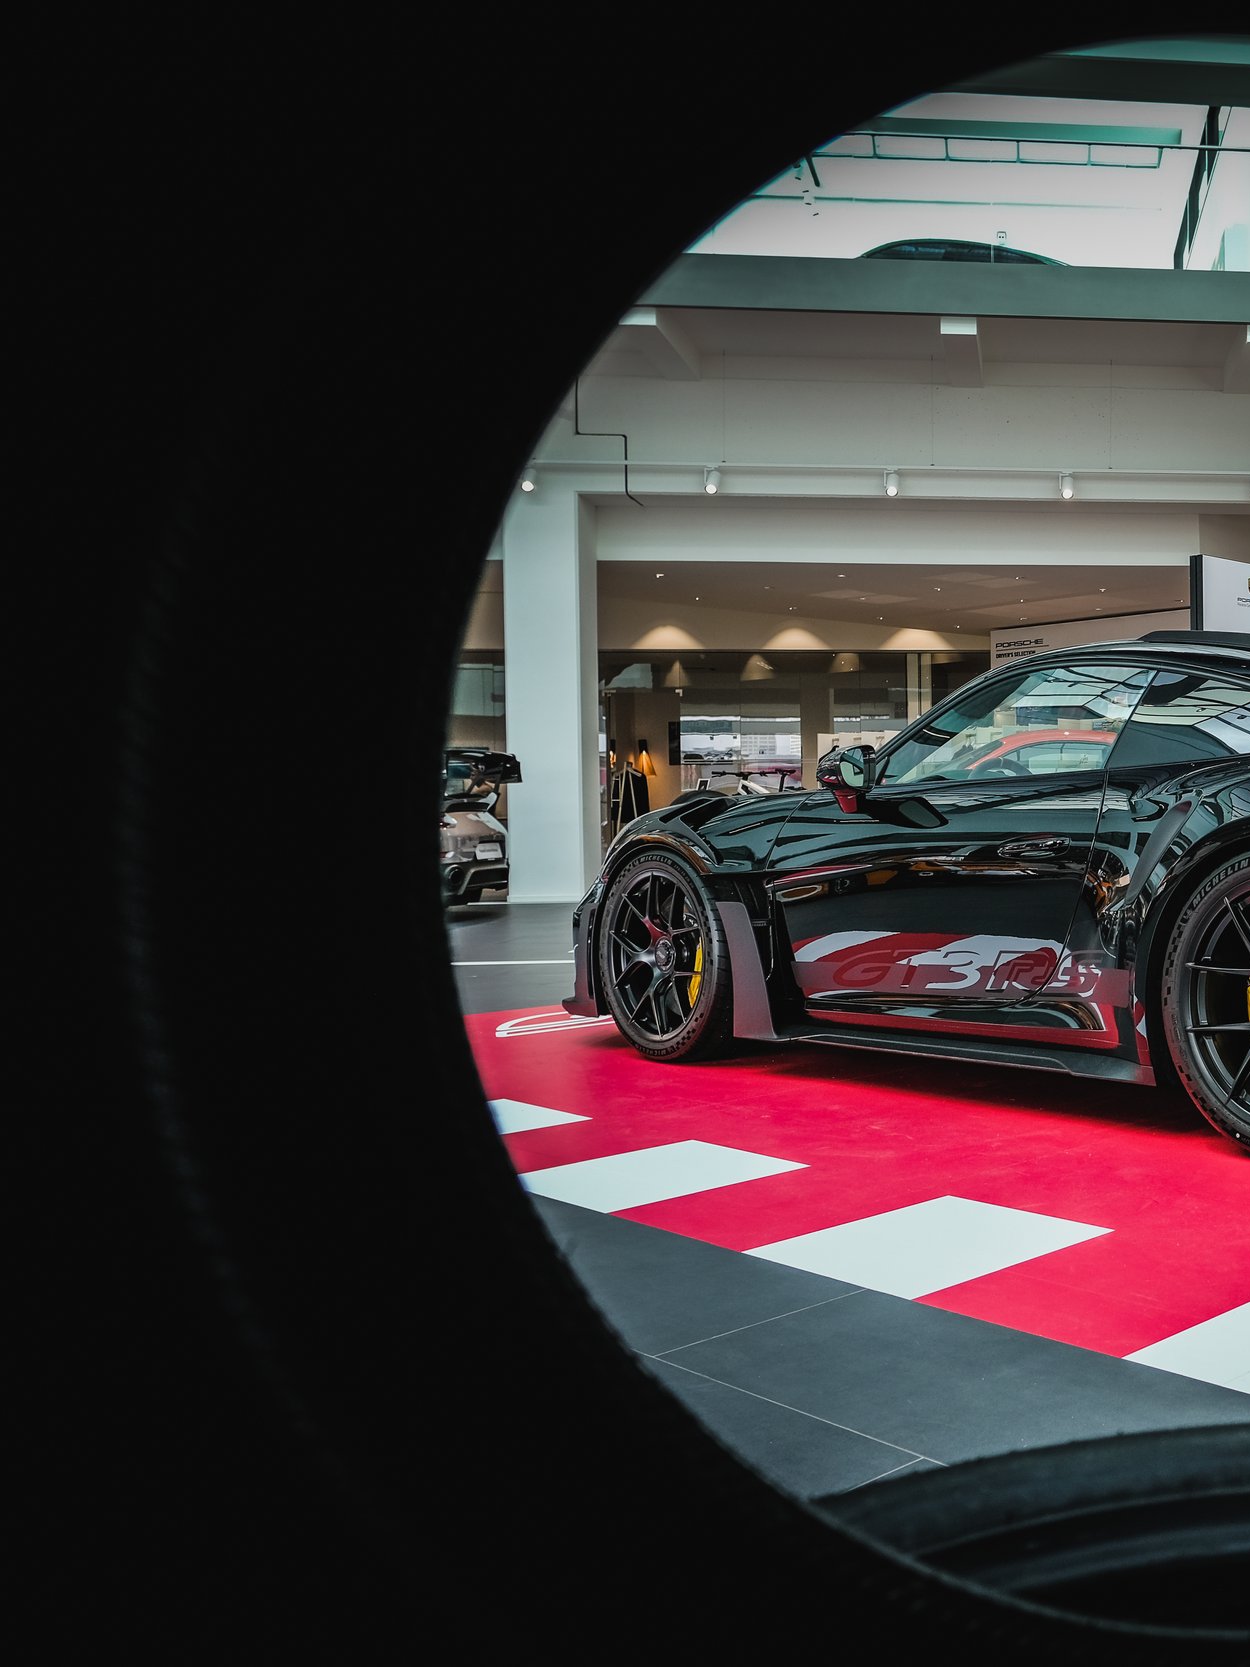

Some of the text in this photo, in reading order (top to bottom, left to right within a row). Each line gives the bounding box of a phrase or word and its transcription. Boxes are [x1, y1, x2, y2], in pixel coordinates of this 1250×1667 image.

[996, 638, 1043, 649] PORSCHE
[639, 855, 673, 865] MICHELIN
[1192, 858, 1249, 908] MICHELIN
